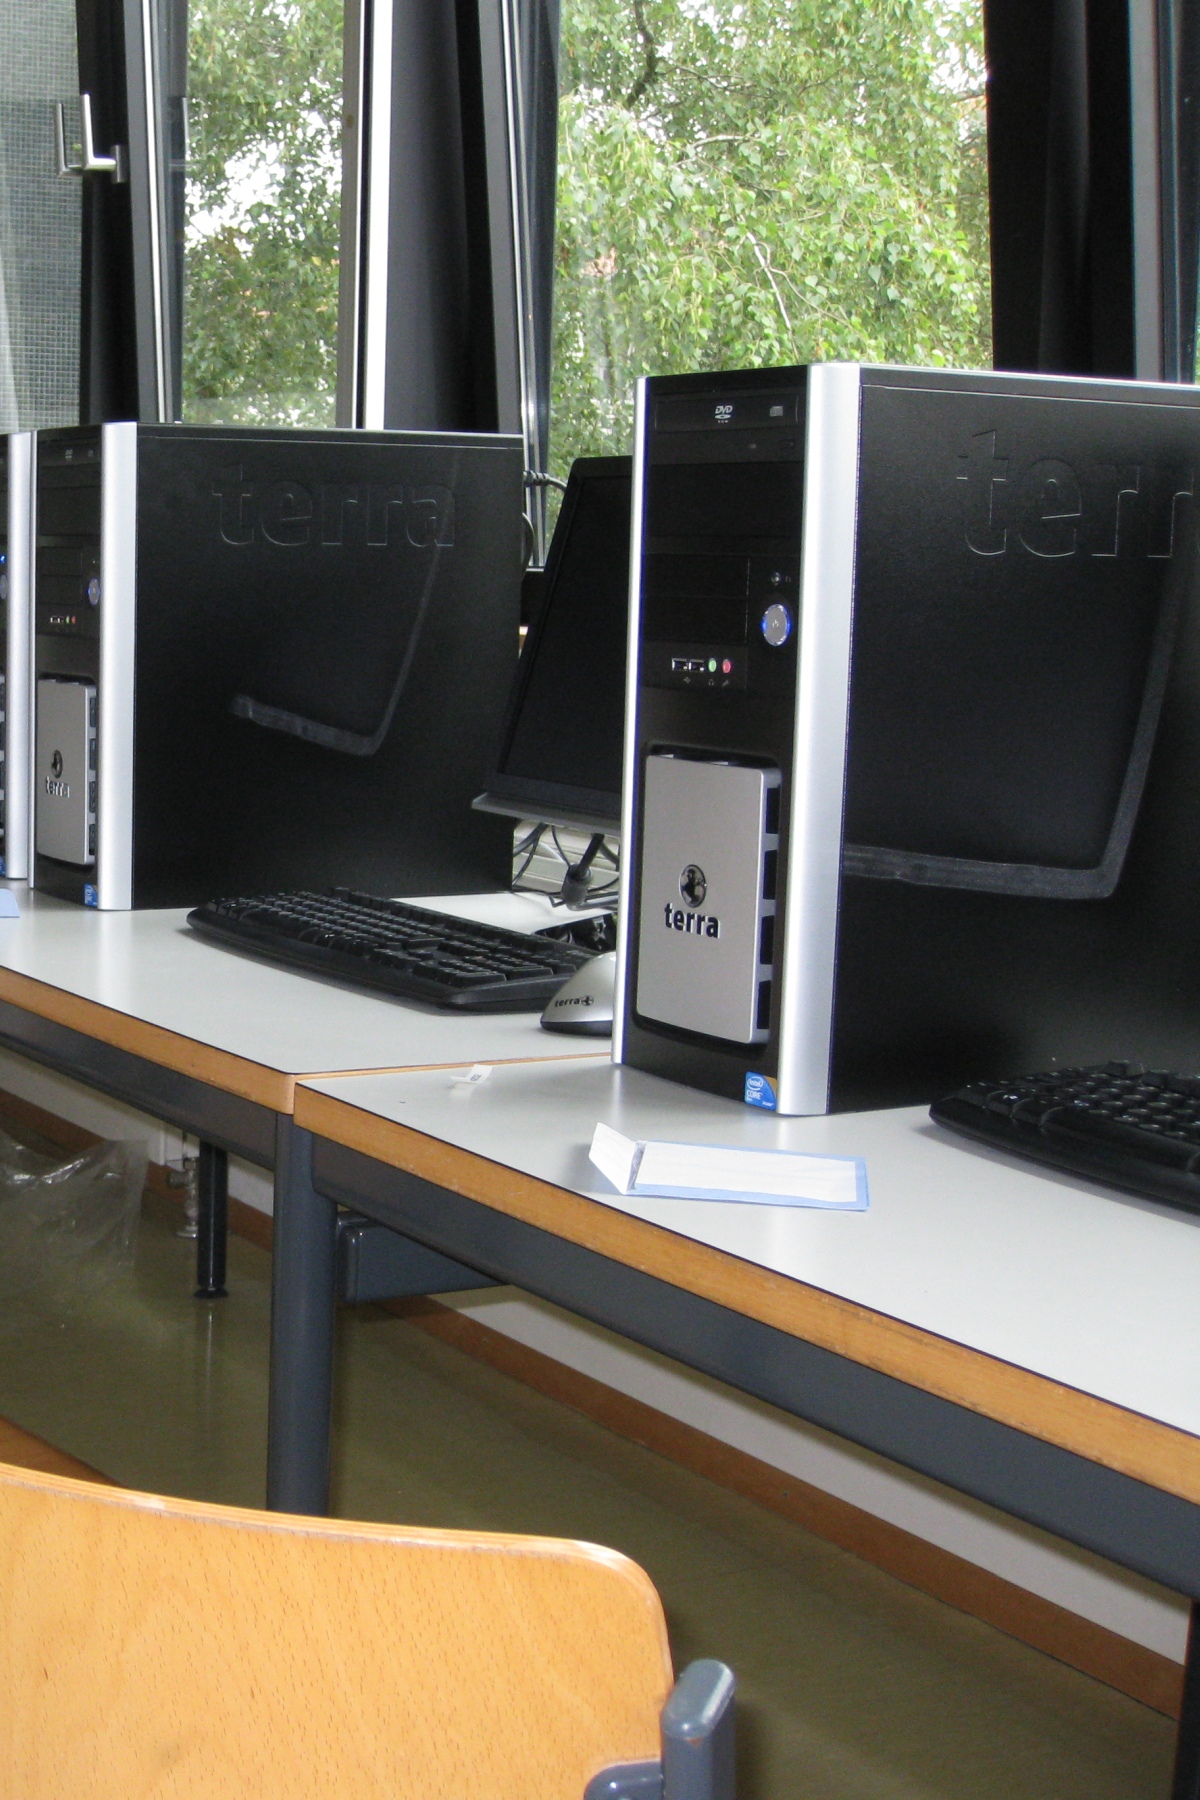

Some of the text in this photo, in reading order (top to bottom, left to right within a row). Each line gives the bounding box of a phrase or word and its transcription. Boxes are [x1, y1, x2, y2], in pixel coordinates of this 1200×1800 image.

[714, 405, 734, 416] DVD
[211, 462, 455, 548] terra
[46, 775, 70, 798] terra
[664, 902, 720, 939] terra
[554, 996, 581, 1008] terra
